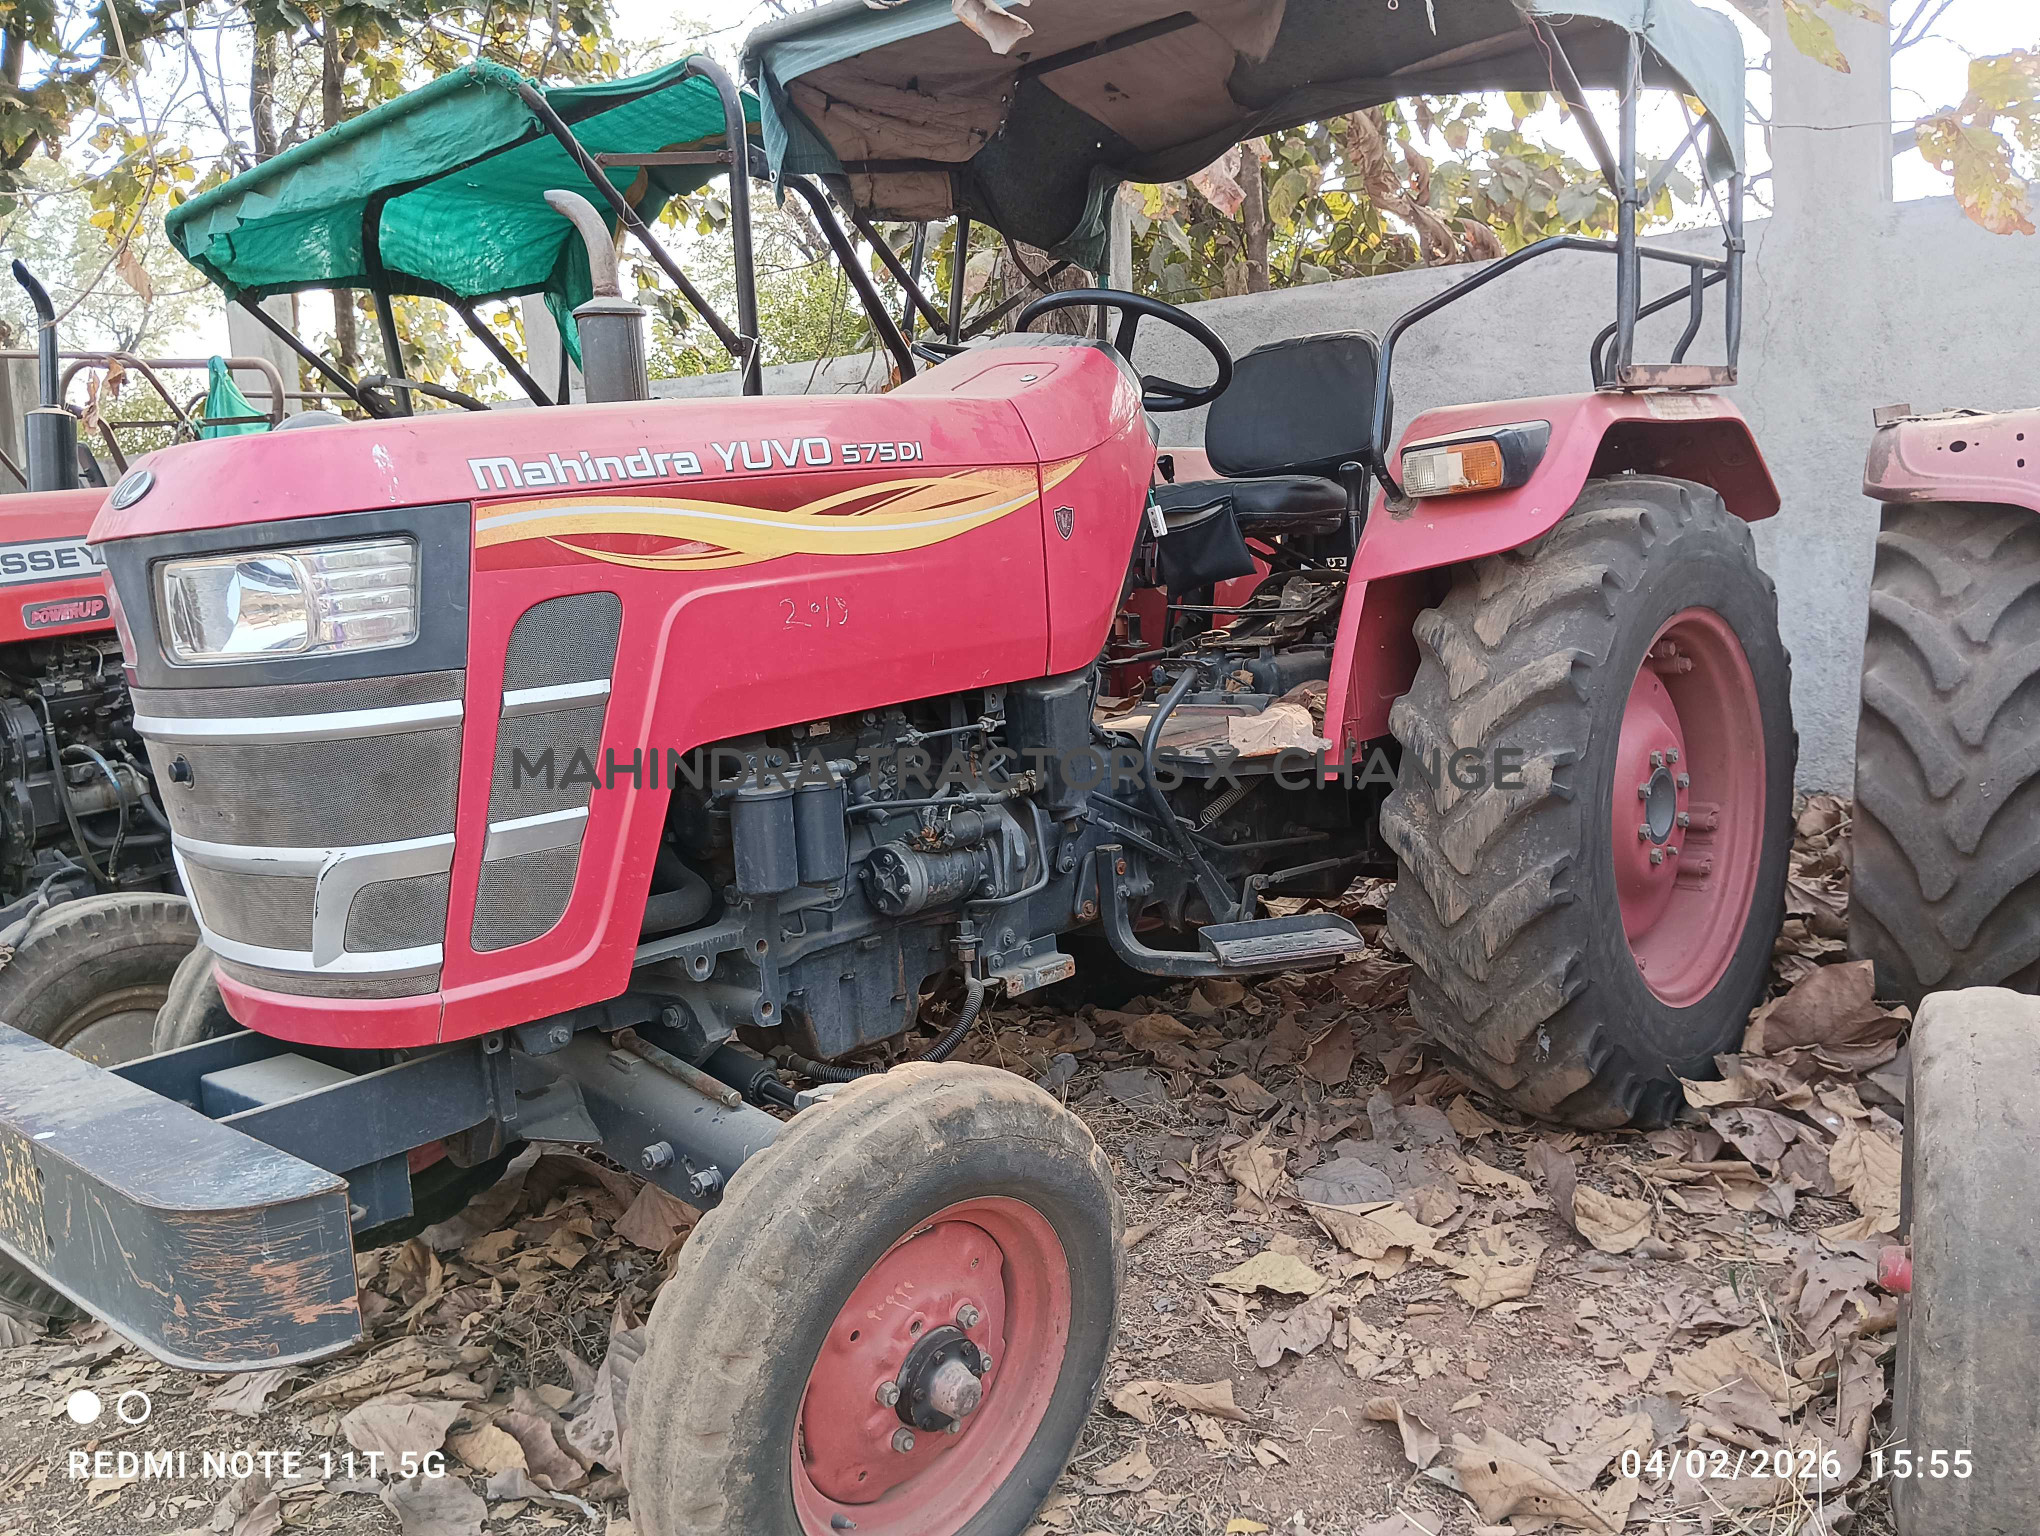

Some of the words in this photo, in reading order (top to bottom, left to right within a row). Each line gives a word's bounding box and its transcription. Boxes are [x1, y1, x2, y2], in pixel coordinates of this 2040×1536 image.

[467, 447, 703, 491] Mahindra
[711, 437, 833, 472] YUVO
[841, 441, 923, 464] 575DI
